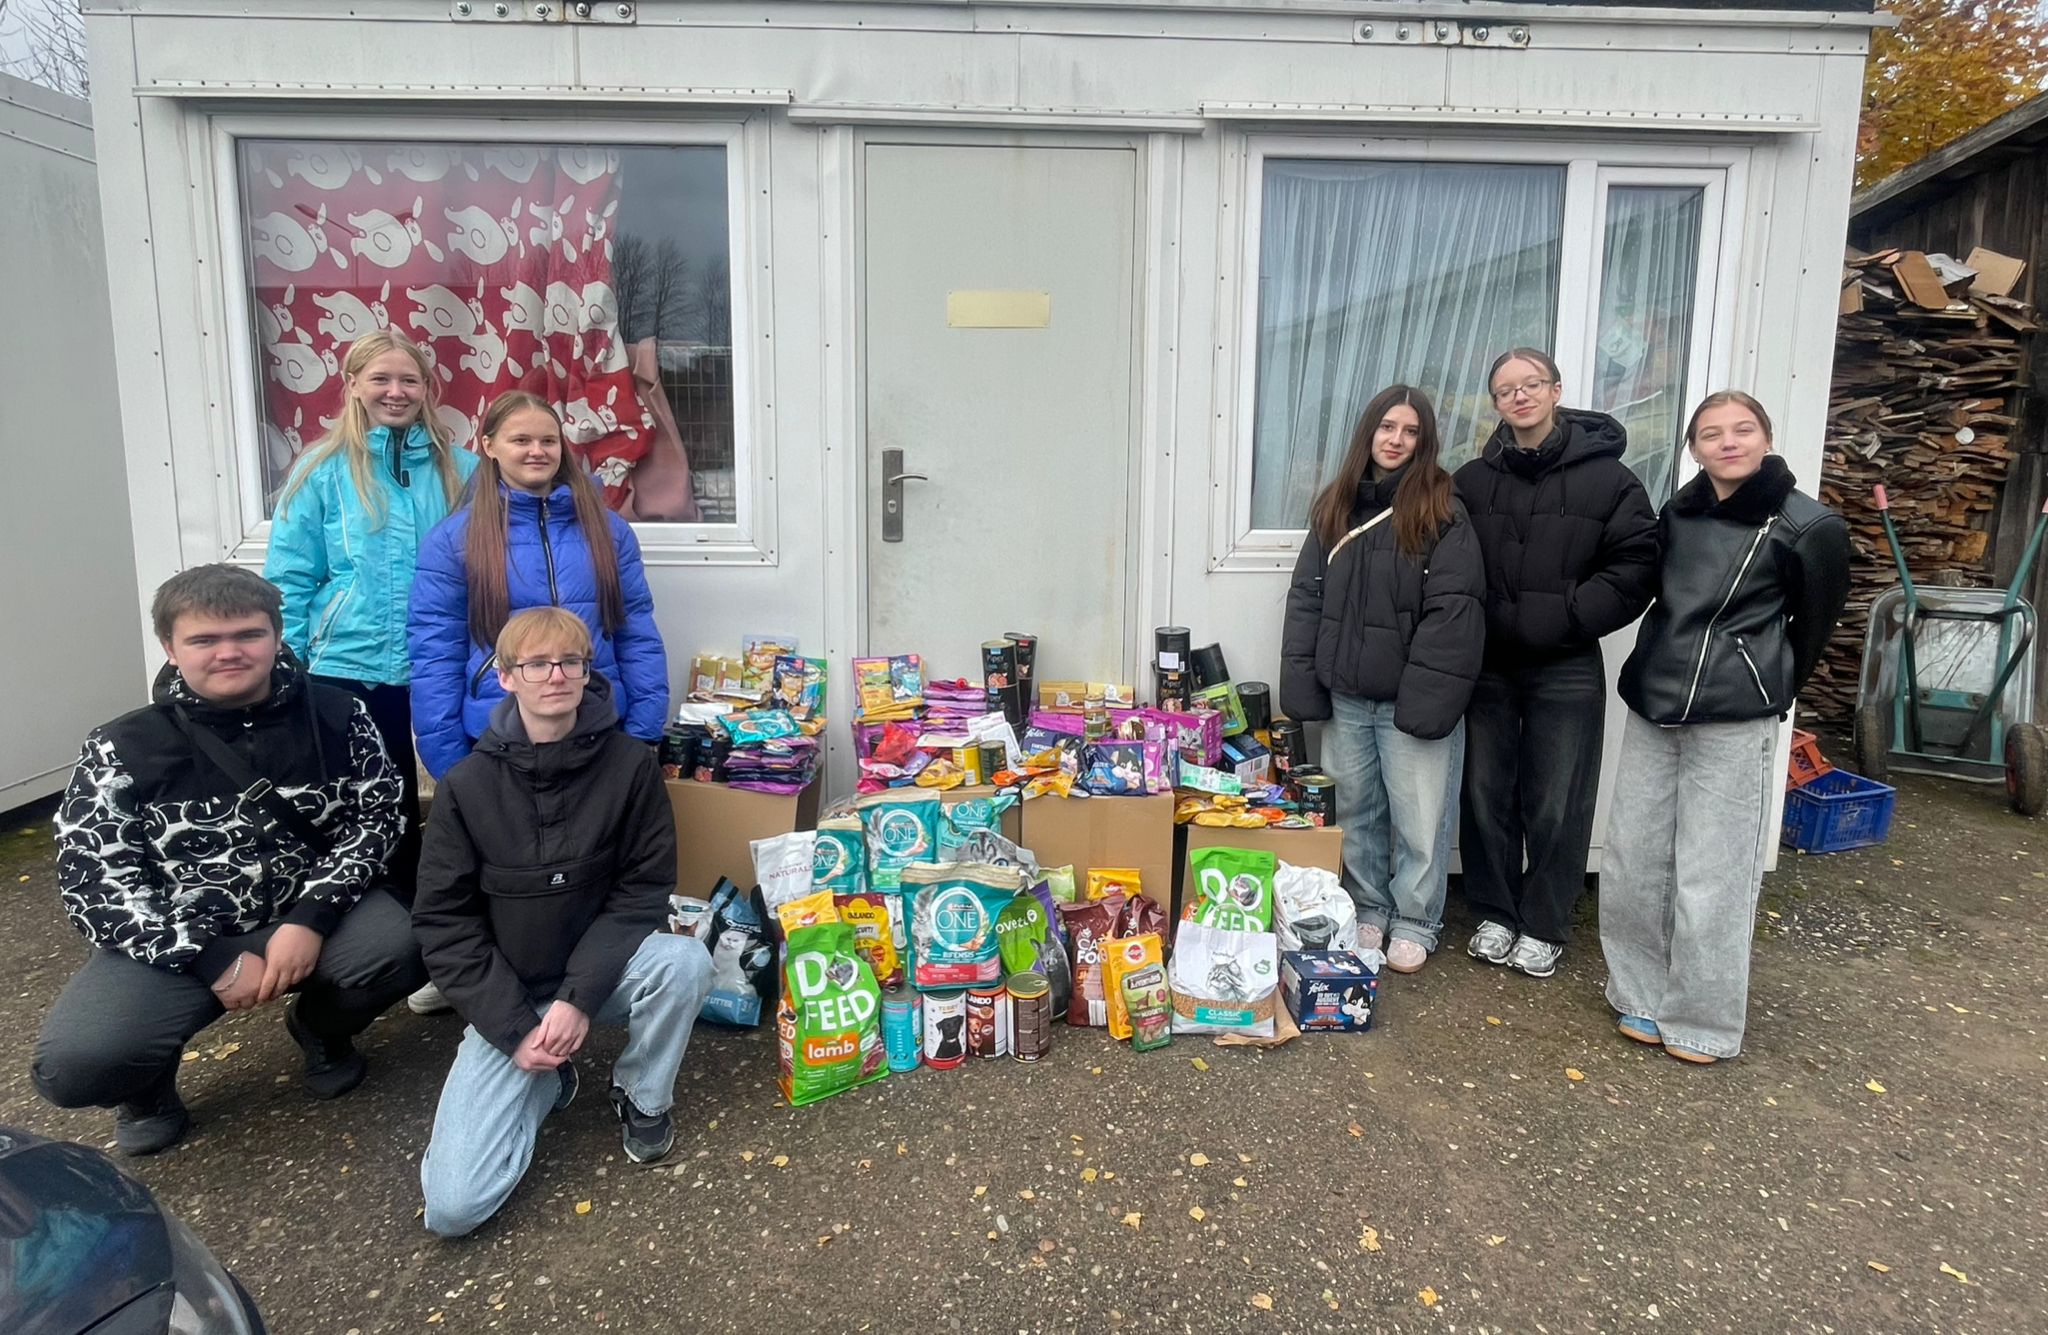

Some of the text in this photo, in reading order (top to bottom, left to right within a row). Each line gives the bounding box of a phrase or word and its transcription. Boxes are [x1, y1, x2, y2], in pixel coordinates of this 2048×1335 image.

[1302, 793, 1323, 802] Piper
[956, 803, 988, 818] ONE
[883, 827, 917, 842] ONE
[812, 853, 838, 867] ONE
[936, 910, 978, 929] ONE
[1307, 982, 1330, 996] felix
[805, 989, 876, 1031] FEED
[1207, 1009, 1241, 1018] CLASSIC
[808, 1040, 855, 1059] lamb
